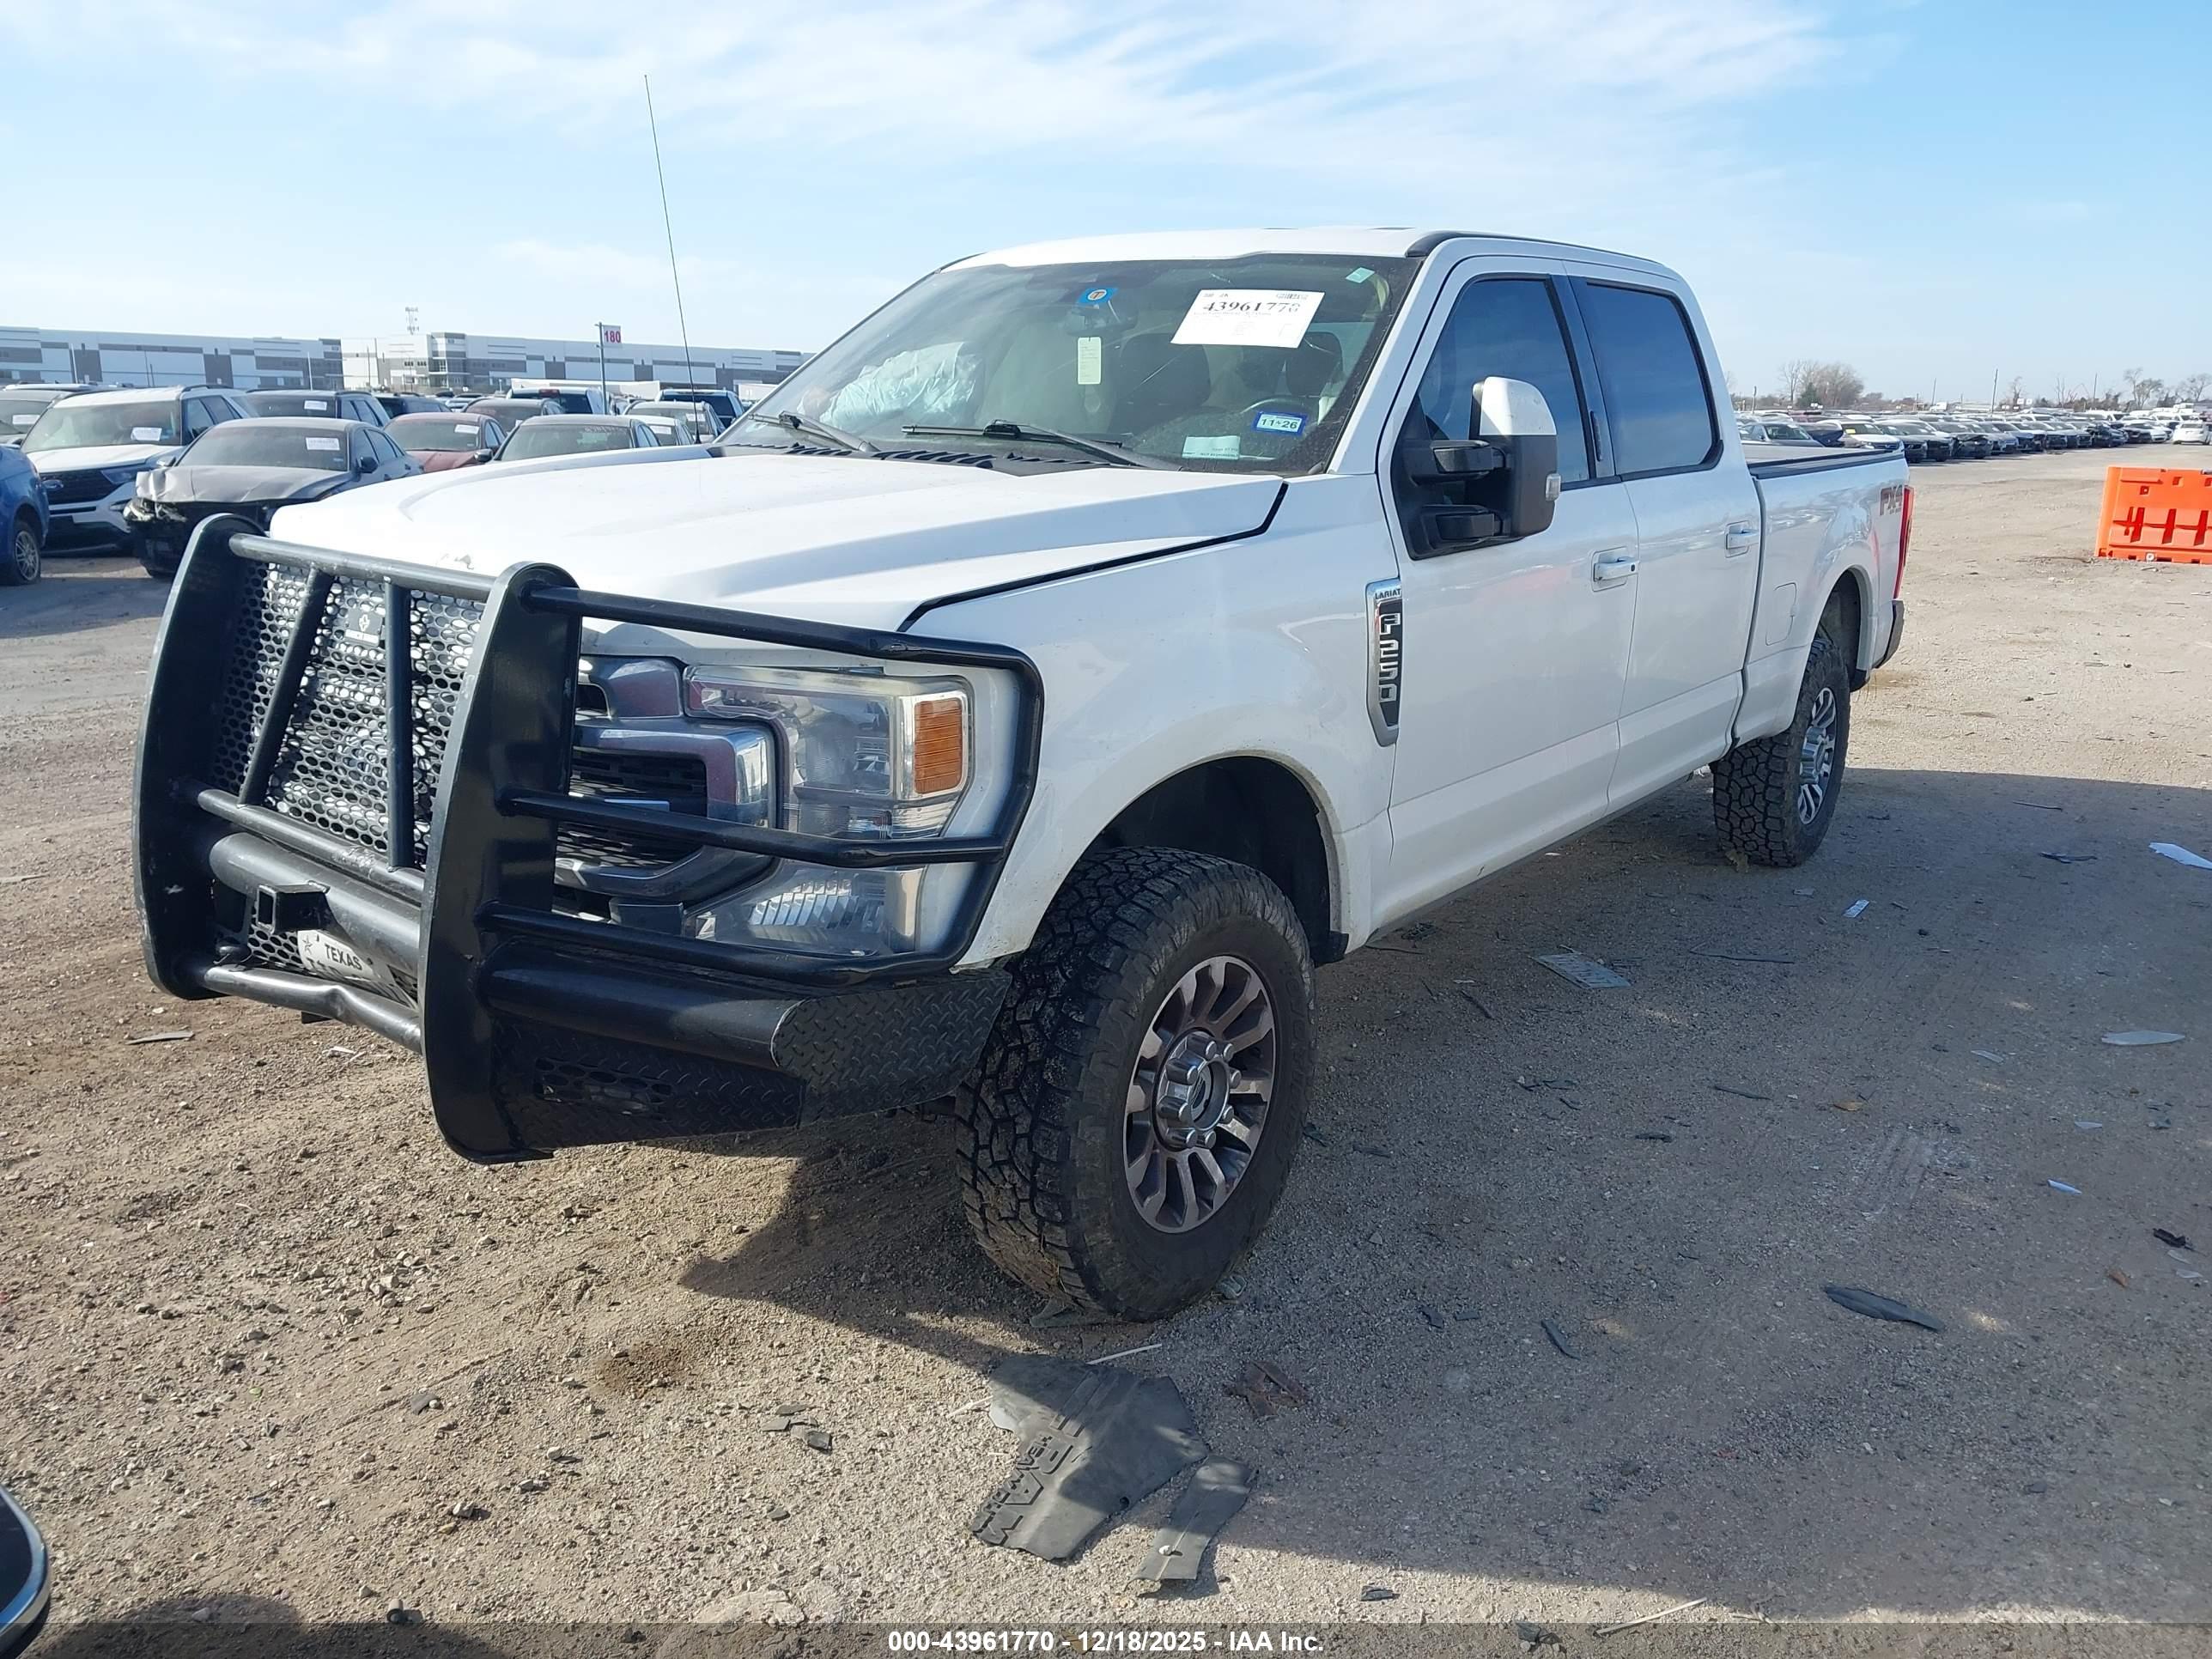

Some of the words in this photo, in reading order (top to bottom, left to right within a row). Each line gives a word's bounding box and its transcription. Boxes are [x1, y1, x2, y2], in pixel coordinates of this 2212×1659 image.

[605, 330, 621, 343] 180
[1261, 417, 1274, 427] 11
[1282, 420, 1298, 429] 26
[1880, 484, 1902, 515] FX4
[1375, 588, 1401, 599] LARIAT
[325, 944, 362, 970] TEXAS
